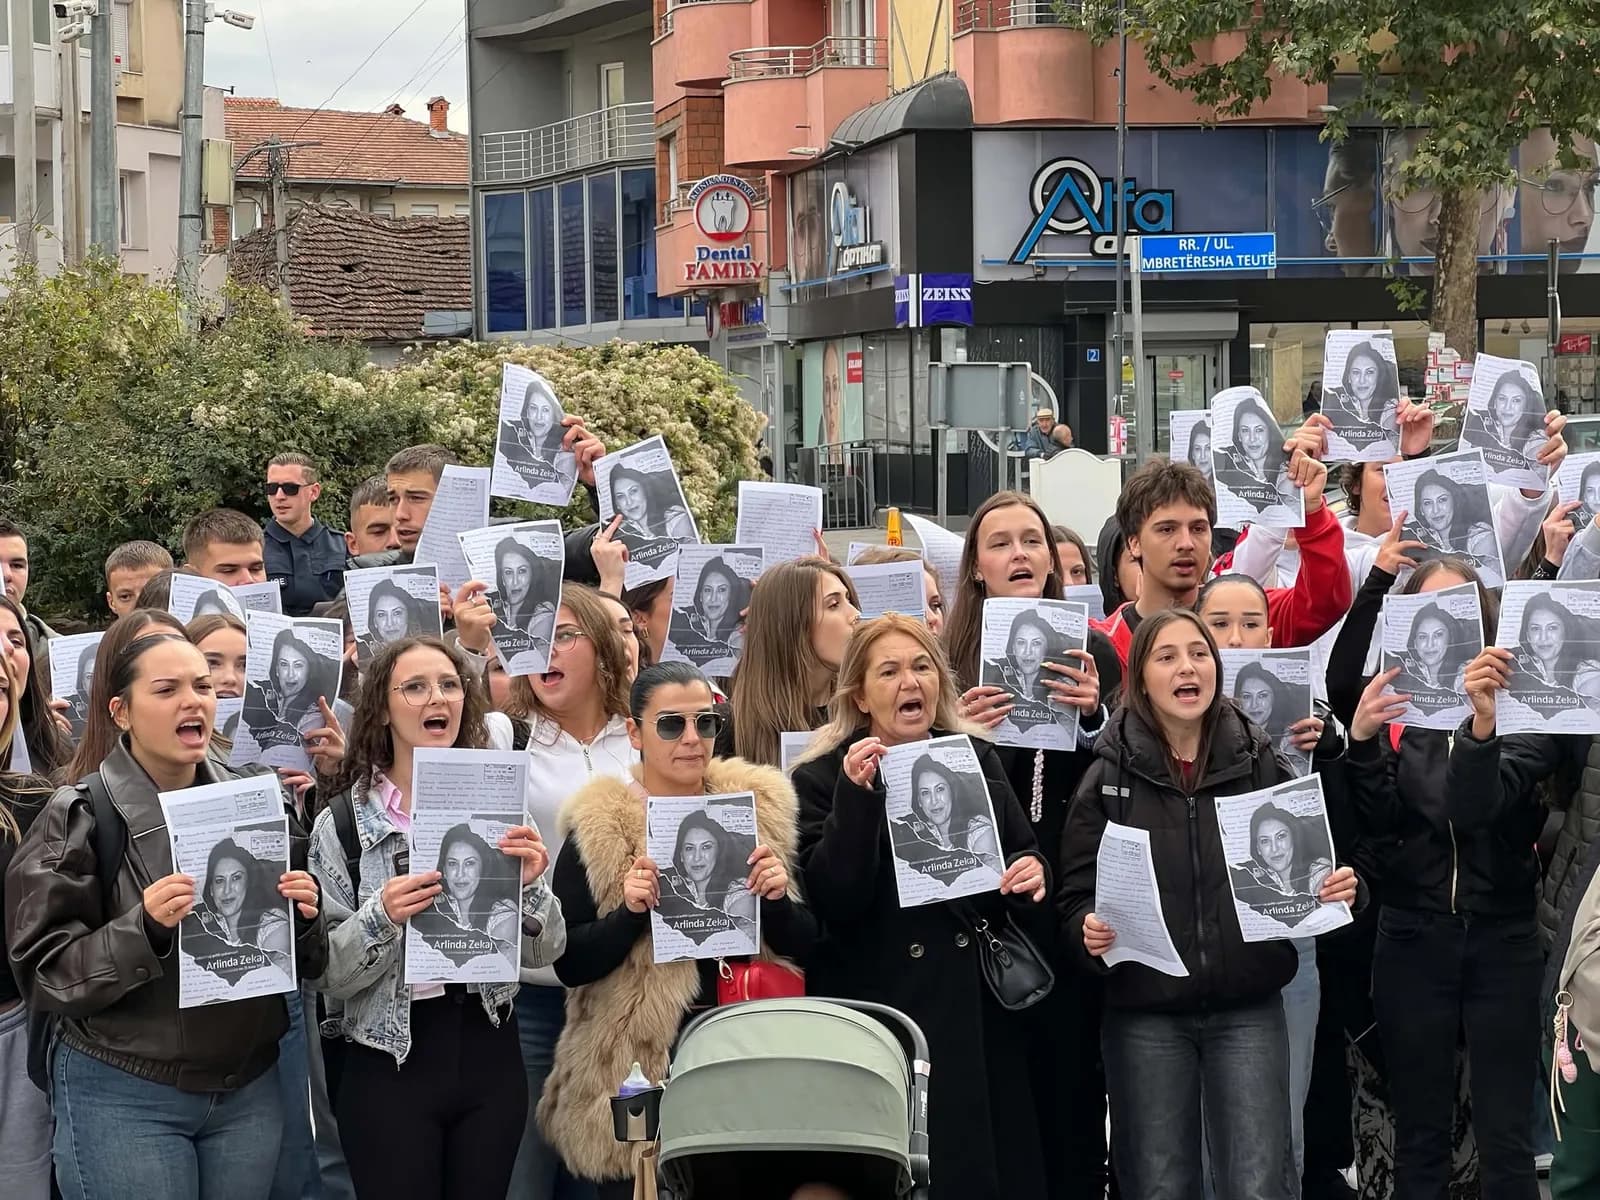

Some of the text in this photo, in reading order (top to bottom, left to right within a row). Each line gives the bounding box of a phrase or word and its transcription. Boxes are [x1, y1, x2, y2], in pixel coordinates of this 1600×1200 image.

[1008, 170, 1174, 264] Alfa
[1179, 239, 1200, 250] RR.
[1214, 238, 1234, 250] UL.
[697, 246, 751, 261] Dental
[1142, 251, 1275, 269] MBRETËRESHA TEUTË
[686, 262, 763, 280] FAMILY
[922, 288, 971, 301] ZEISS
[1090, 350, 1096, 360] 2
[1339, 430, 1366, 438] Arlinda
[1484, 452, 1505, 462] rlinda
[514, 465, 538, 476] Arlinda
[1239, 490, 1264, 498] Arlinda
[631, 548, 658, 562] Arlinda
[683, 648, 710, 656] Arlinda
[1411, 694, 1460, 705] linda Zekaj
[1520, 696, 1580, 706] Arlinda Zekaj
[1008, 708, 1052, 720] linda Zekaj
[921, 861, 952, 874] Arlinda
[952, 856, 977, 867] Zekaj
[1262, 904, 1295, 916] Arlinda
[673, 917, 730, 929] Arlinda Zekaj
[433, 940, 493, 950] Arlinda Zekaj
[206, 958, 238, 971] Arlinda
[239, 954, 266, 964] Zekaj
